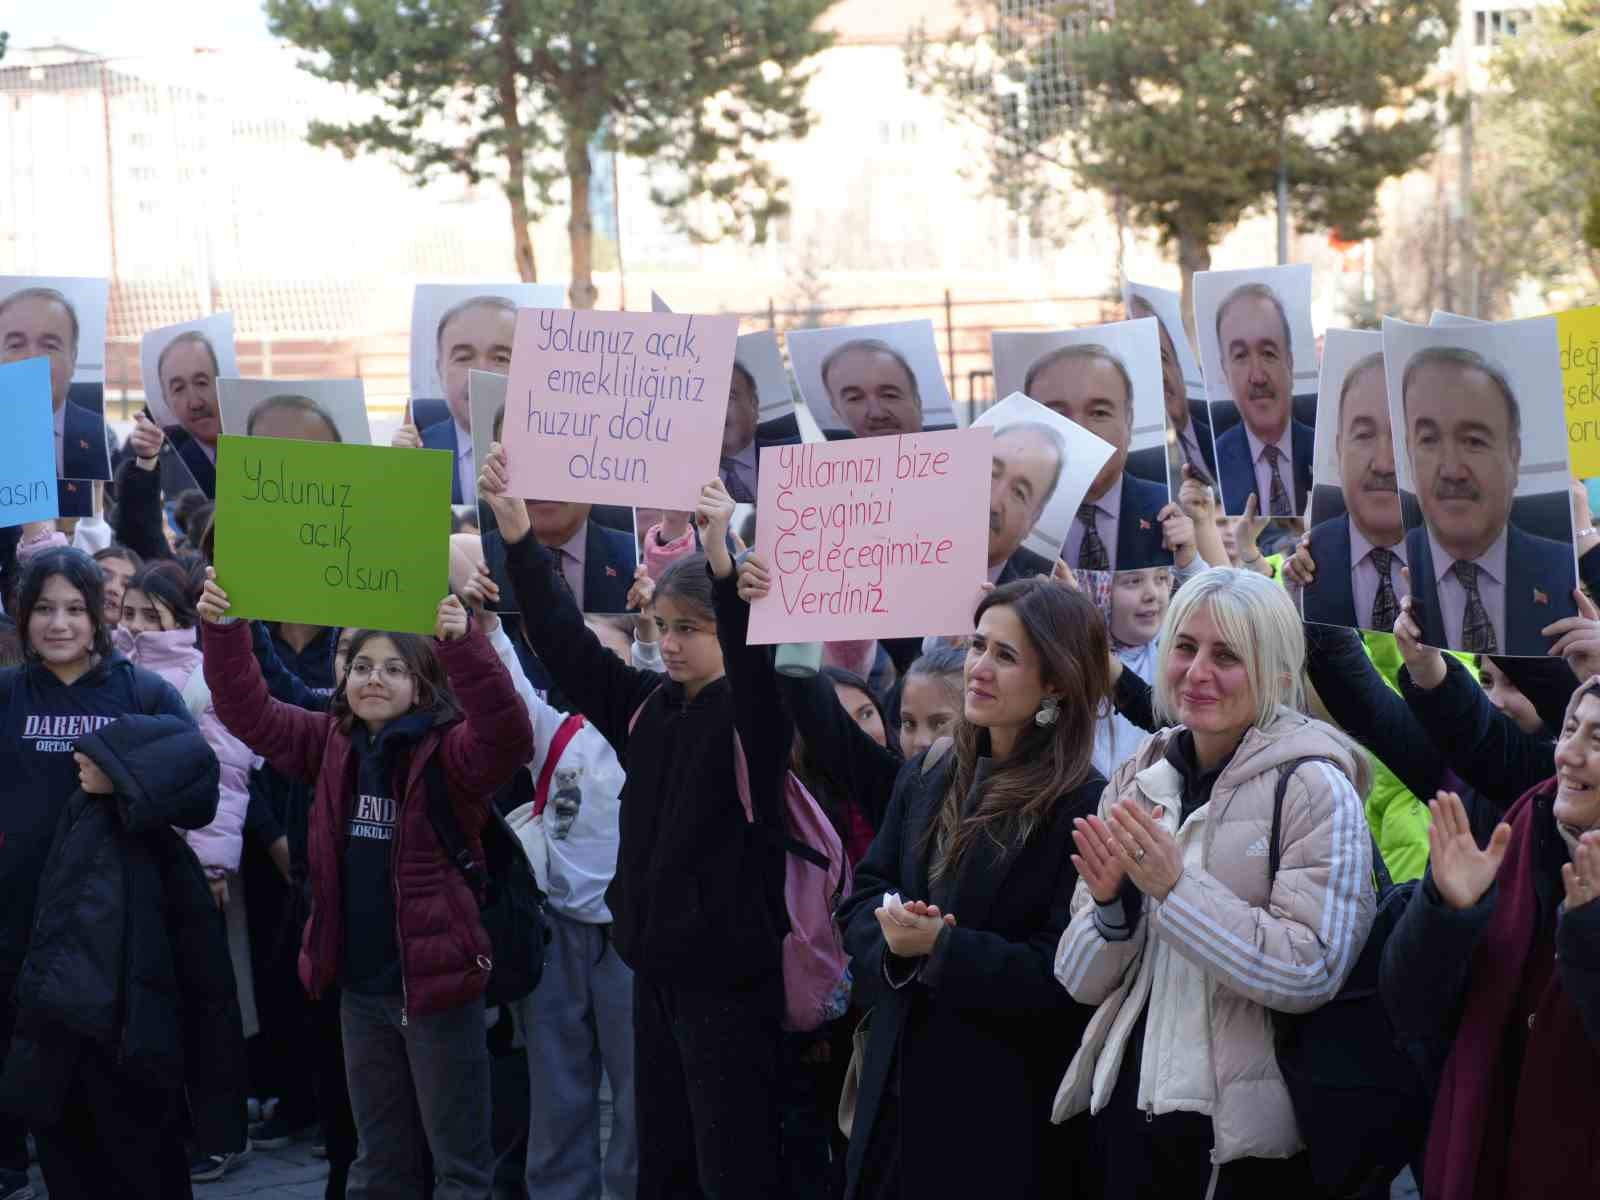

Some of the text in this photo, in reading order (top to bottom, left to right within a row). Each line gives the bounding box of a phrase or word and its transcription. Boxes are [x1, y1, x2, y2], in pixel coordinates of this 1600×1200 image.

[537, 311, 635, 355] Yolunuz
[547, 353, 706, 415] emekliliğiniz
[526, 390, 672, 442] huzur dolu
[895, 434, 950, 480] bize
[241, 456, 353, 508] Yolunuz
[299, 509, 352, 549] açık
[776, 487, 895, 546] Sevginizi
[23, 715, 118, 736] DAREND
